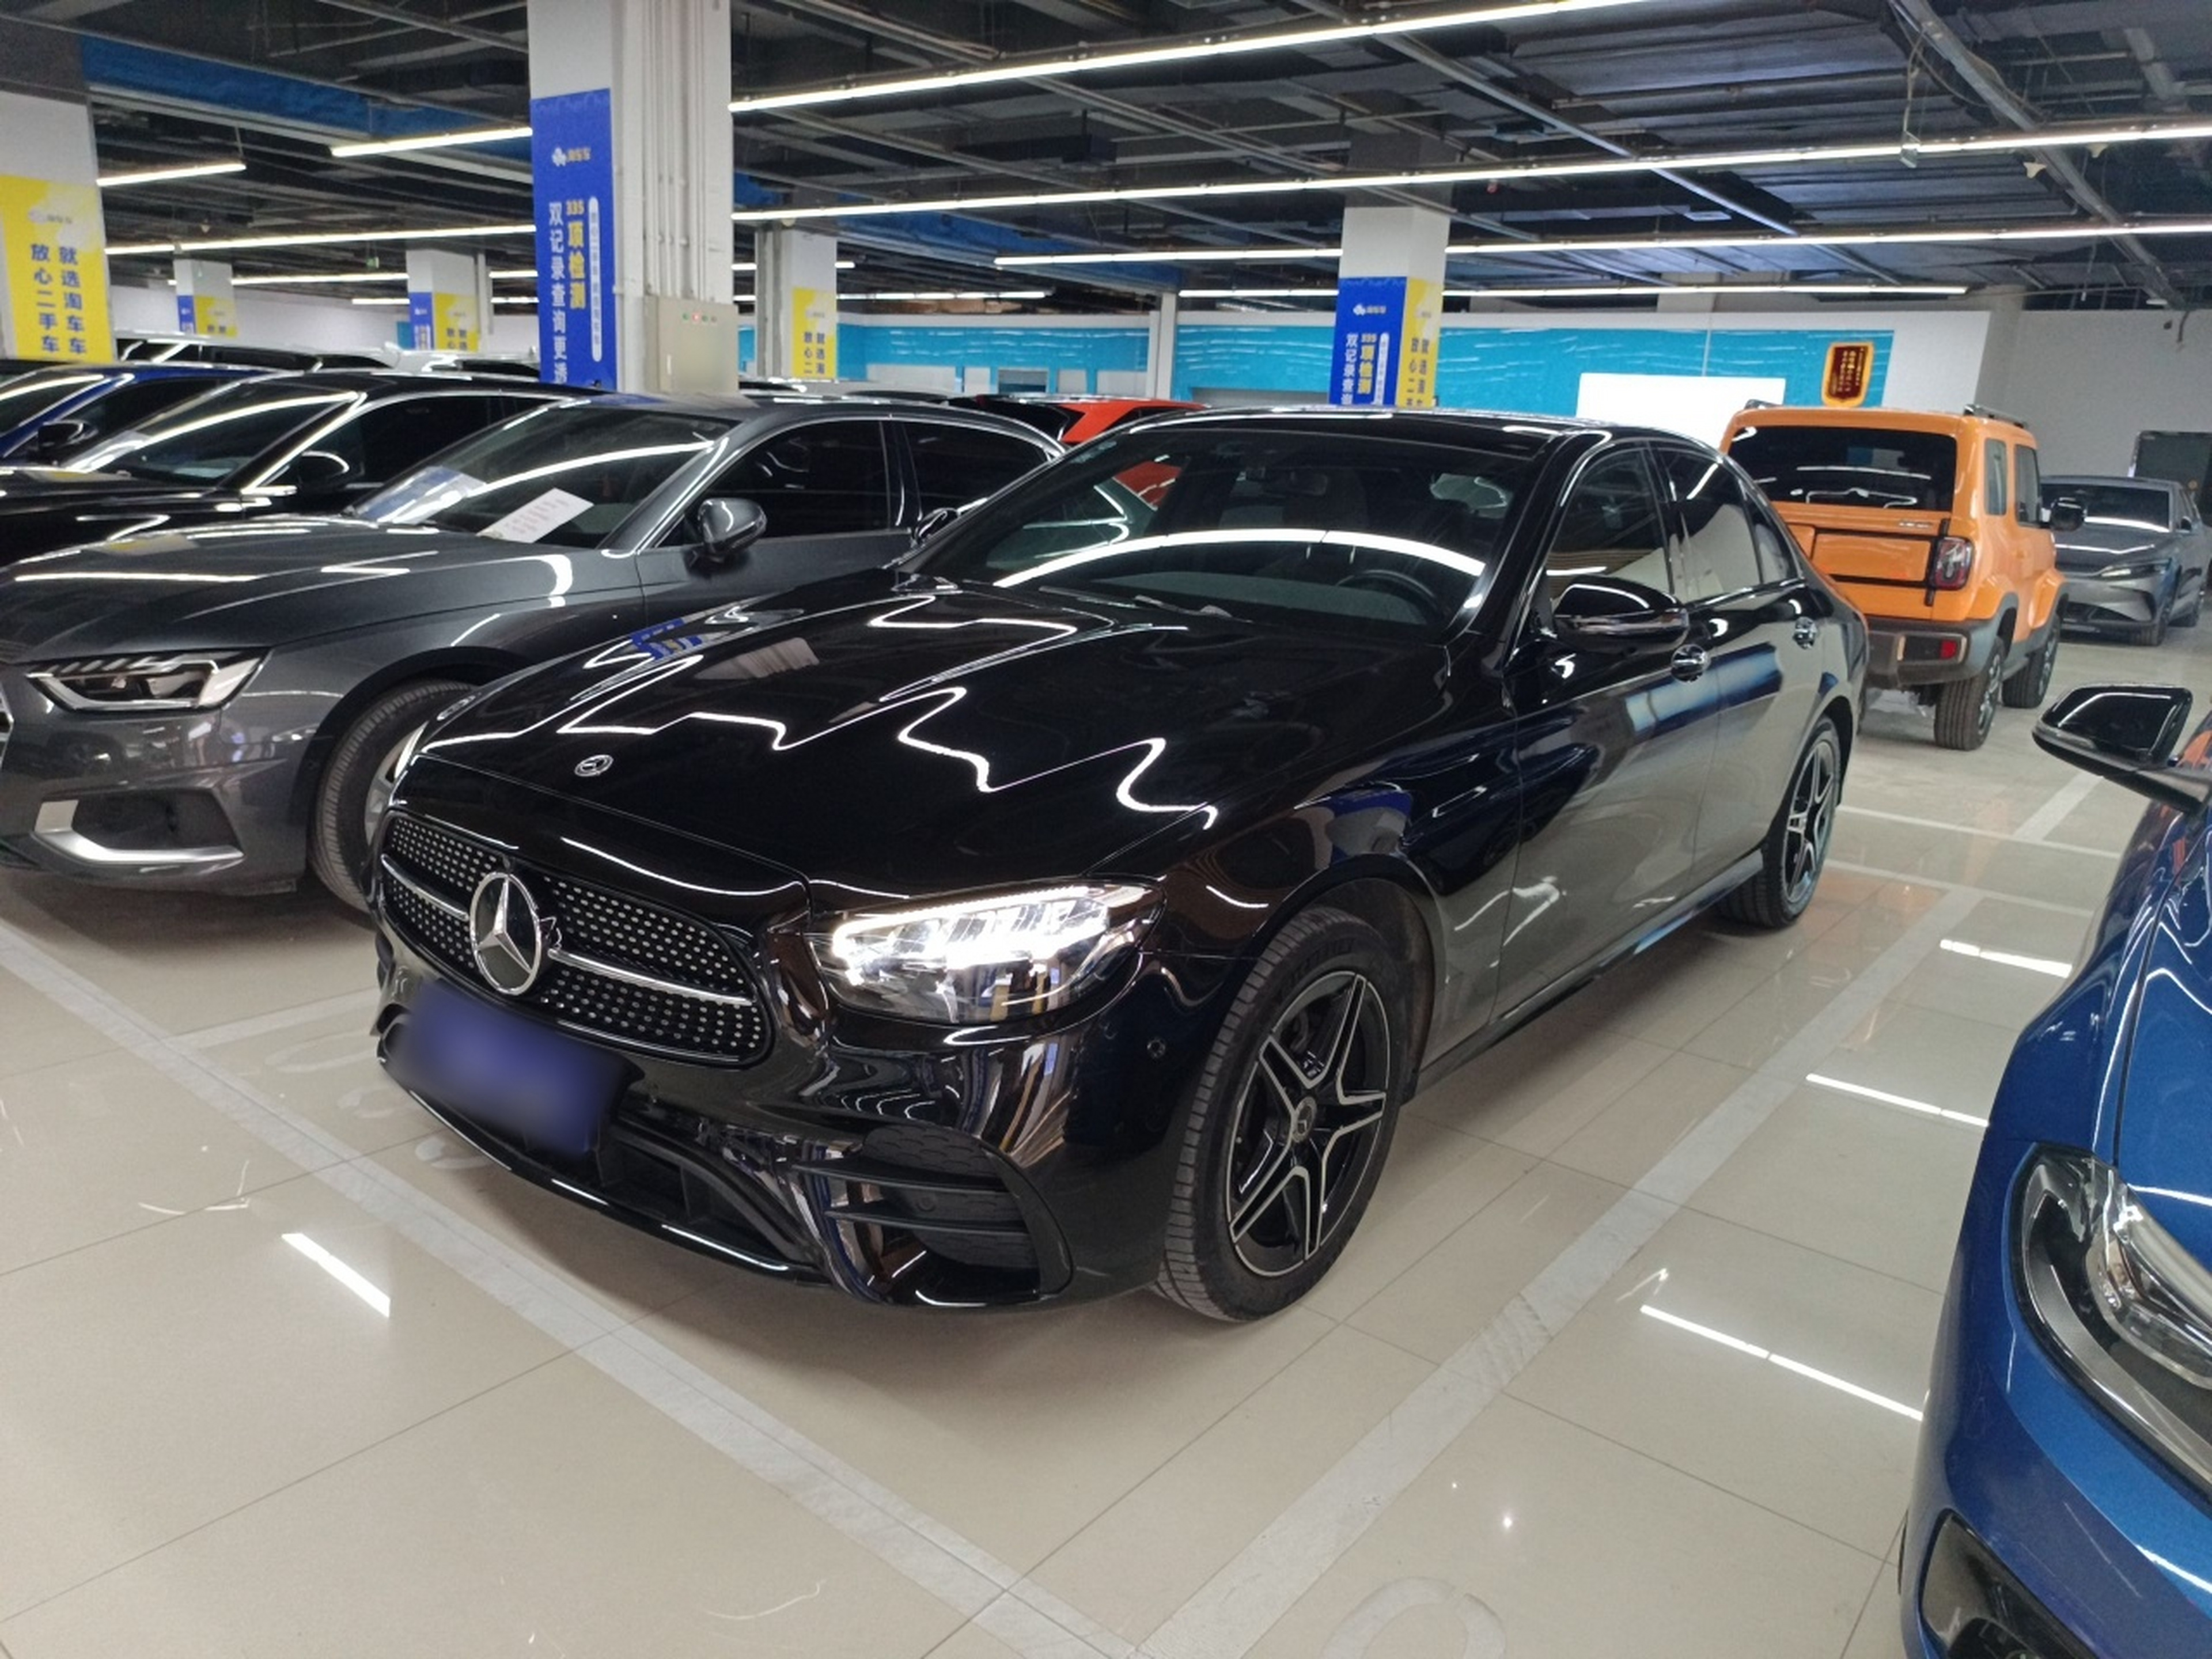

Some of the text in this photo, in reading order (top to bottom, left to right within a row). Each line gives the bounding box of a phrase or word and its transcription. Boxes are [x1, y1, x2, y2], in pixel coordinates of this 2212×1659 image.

[31, 243, 59, 353] 放心二手车
[59, 246, 87, 354] 就选淘车车
